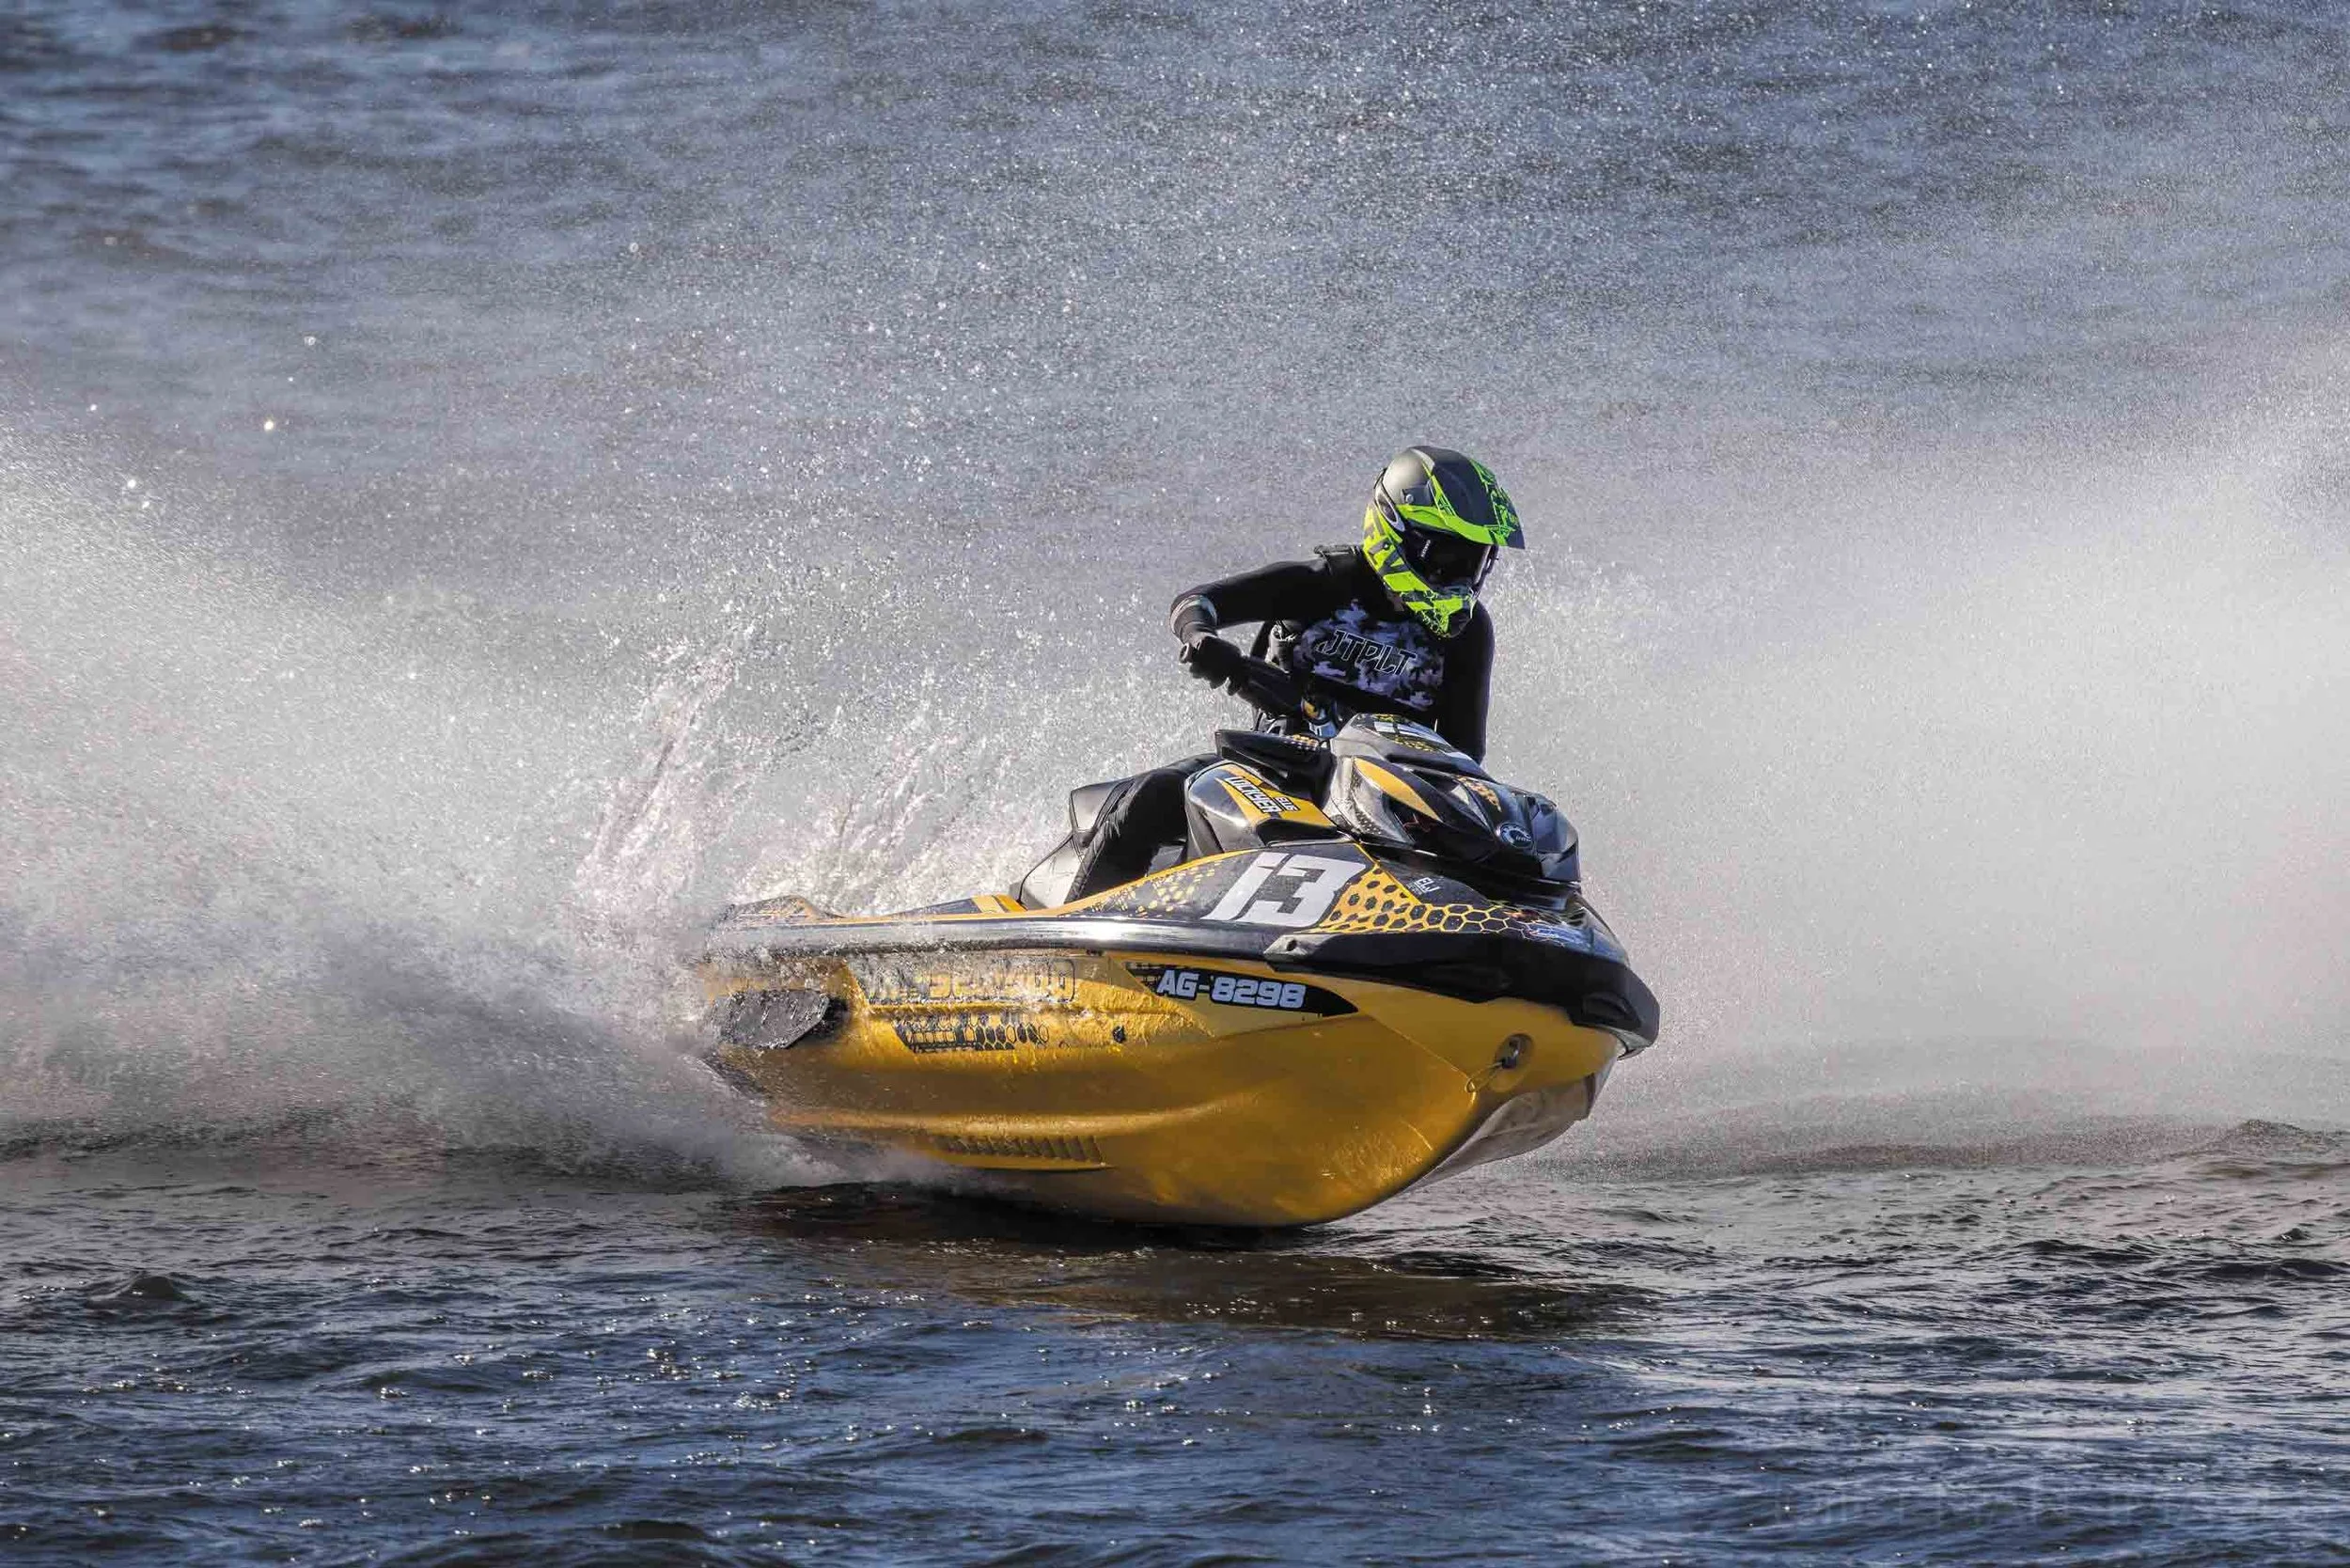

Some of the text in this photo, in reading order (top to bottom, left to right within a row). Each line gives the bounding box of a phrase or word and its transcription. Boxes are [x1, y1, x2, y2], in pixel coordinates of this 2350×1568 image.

[1315, 629, 1418, 676] JTPLT
[1202, 852, 1366, 927] 13
[1156, 969, 1307, 1009] AG-8298
